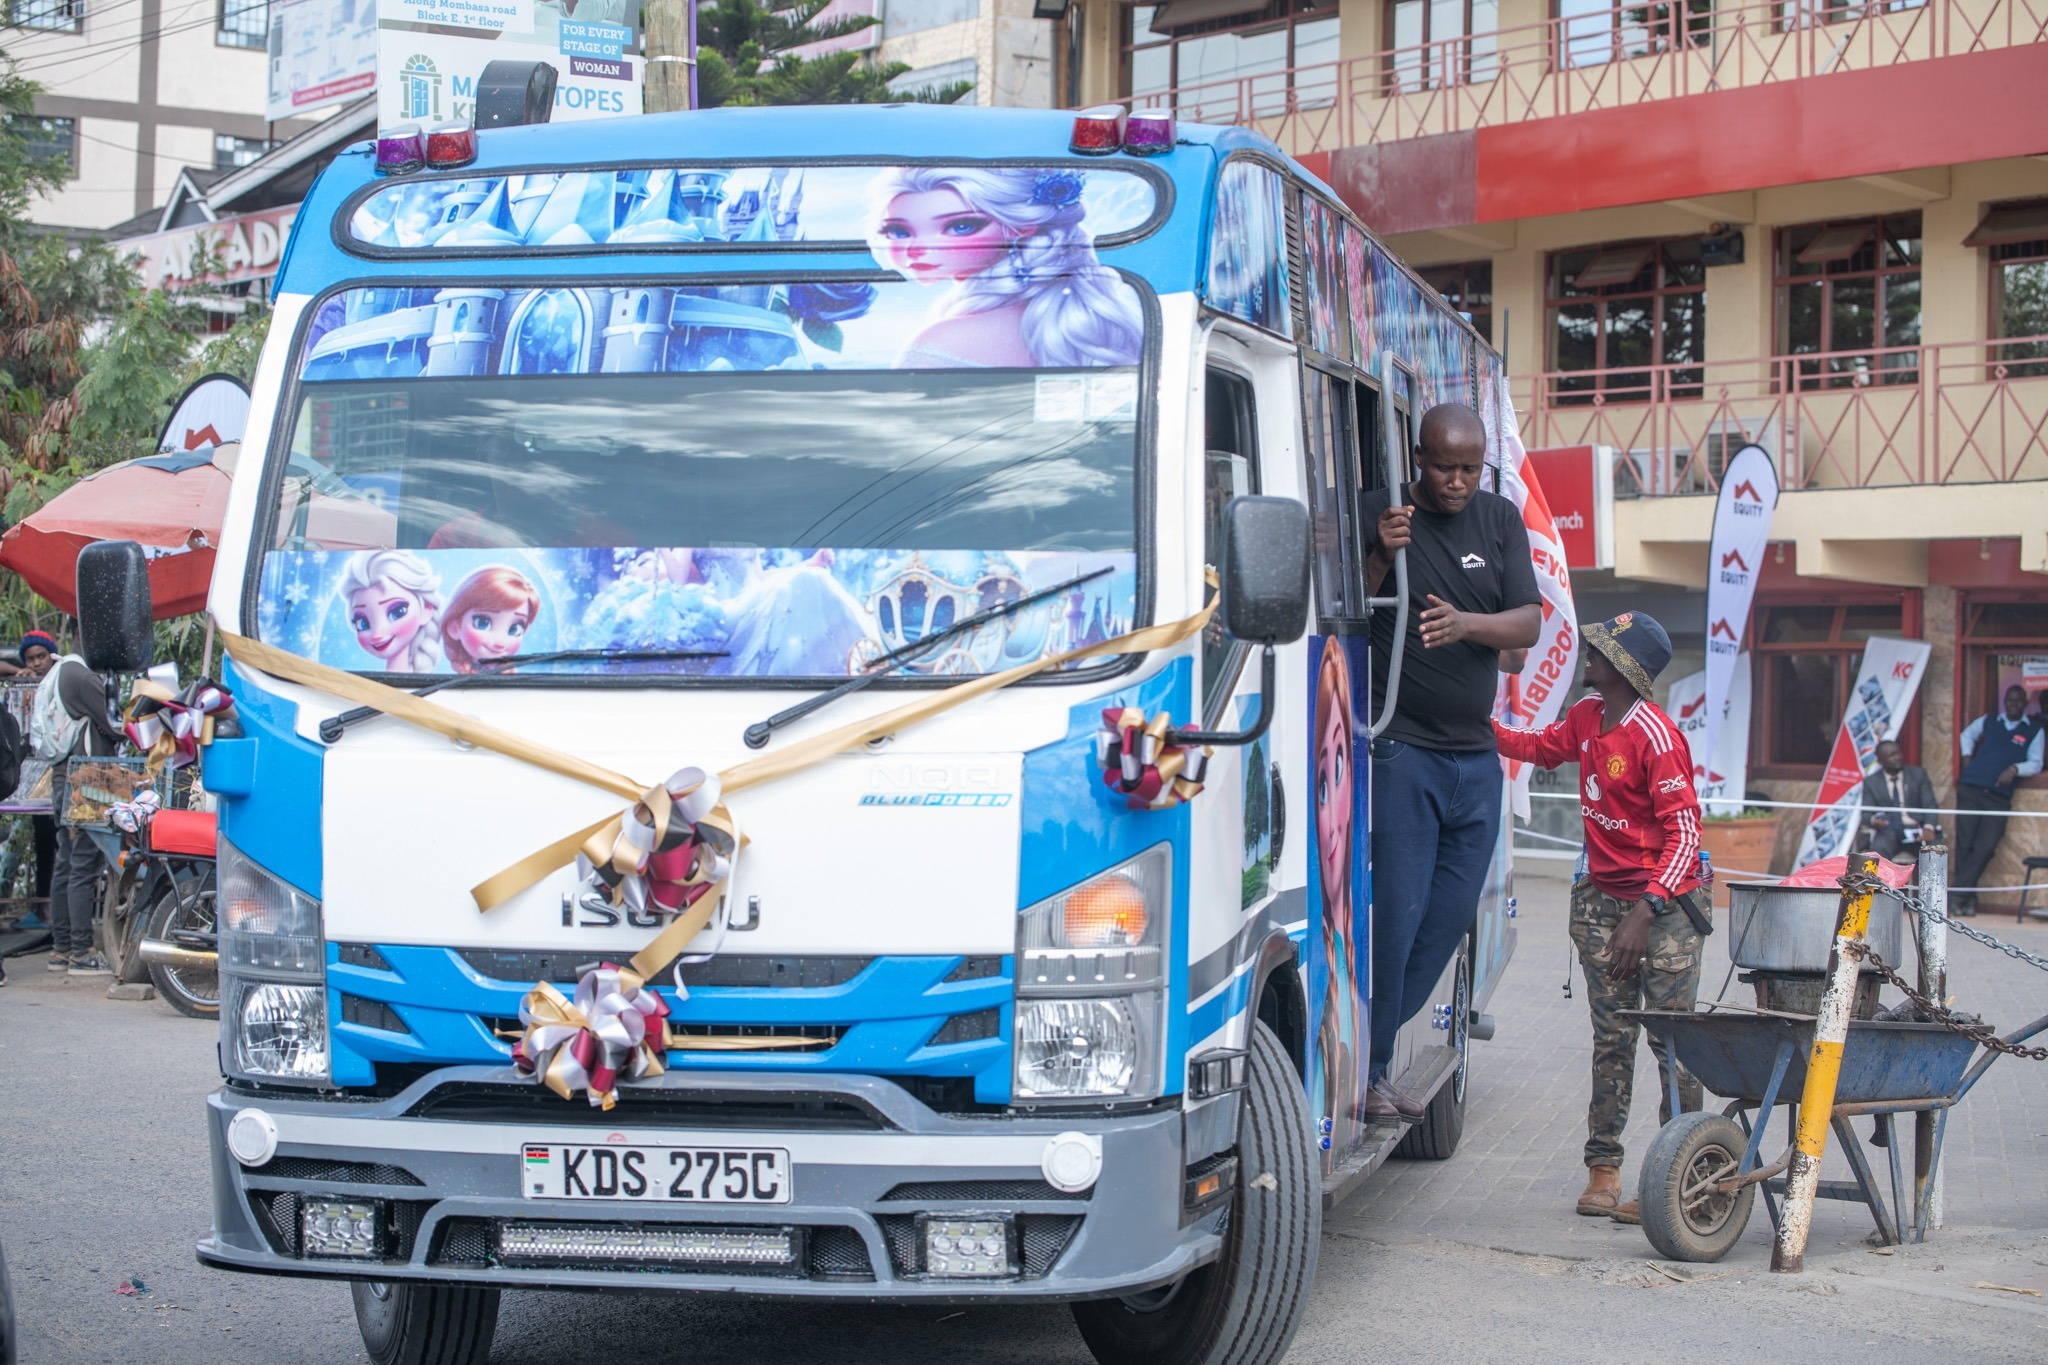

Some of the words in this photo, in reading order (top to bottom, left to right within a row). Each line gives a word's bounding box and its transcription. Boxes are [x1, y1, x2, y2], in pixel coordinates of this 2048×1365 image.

[439, 0, 490, 12] Mombasa
[493, 6, 517, 15] road
[417, 10, 447, 22] Block
[479, 17, 504, 28] floor
[563, 24, 586, 37] FOR
[588, 28, 625, 41] EVERY
[563, 40, 599, 53] STAGE
[603, 44, 619, 56] OF
[574, 61, 620, 76] WOMAN
[555, 85, 625, 113] TOPES
[1733, 502, 1763, 517] EQUITY
[1553, 510, 1584, 530] anch
[1462, 561, 1486, 569] EQUITY
[1532, 548, 1572, 598] EYO
[1710, 640, 1738, 655] EQUITY
[563, 1148, 648, 1197] KDS
[669, 1151, 779, 1200] 275C
